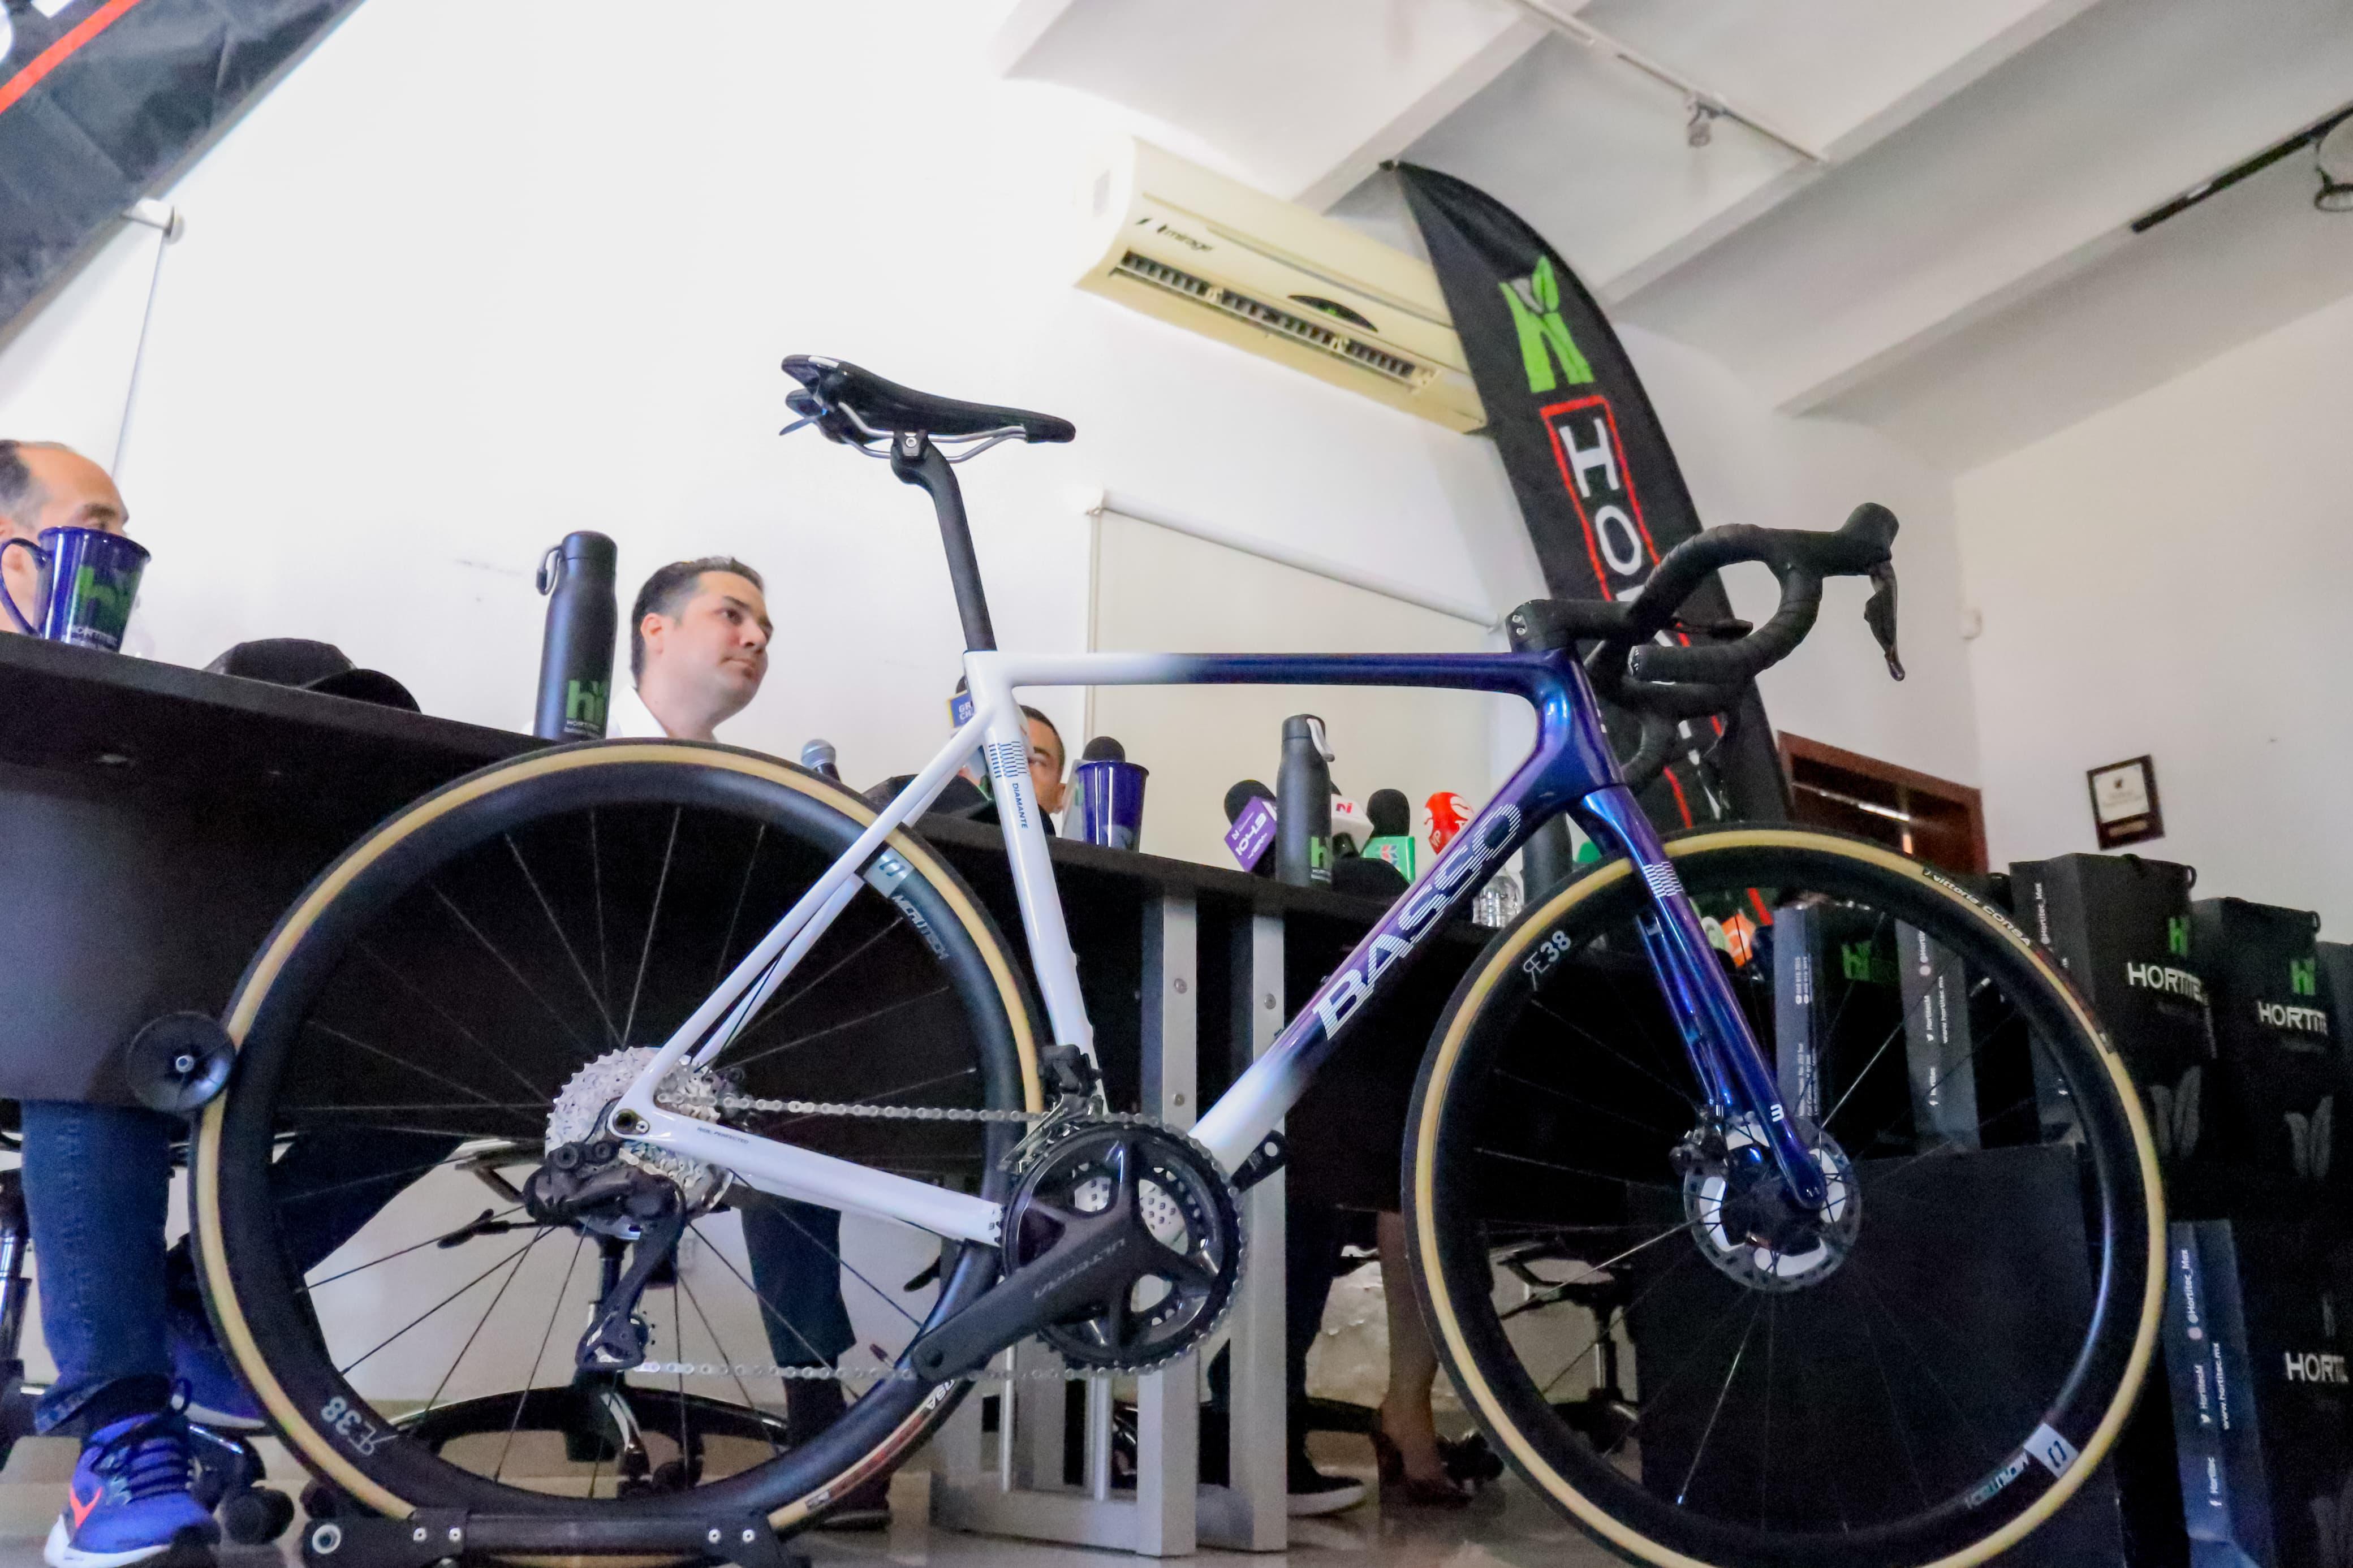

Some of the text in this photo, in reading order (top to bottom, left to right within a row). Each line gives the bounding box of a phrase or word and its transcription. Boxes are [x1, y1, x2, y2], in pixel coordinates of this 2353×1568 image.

[1012, 783, 1028, 829] DIAMANTE
[1312, 804, 1522, 1041] BASSO
[1982, 905, 2031, 947] CORSA
[2180, 1249, 2199, 1324] @Hortitec_Mex
[2212, 1342, 2230, 1430] www.hortitec.mx
